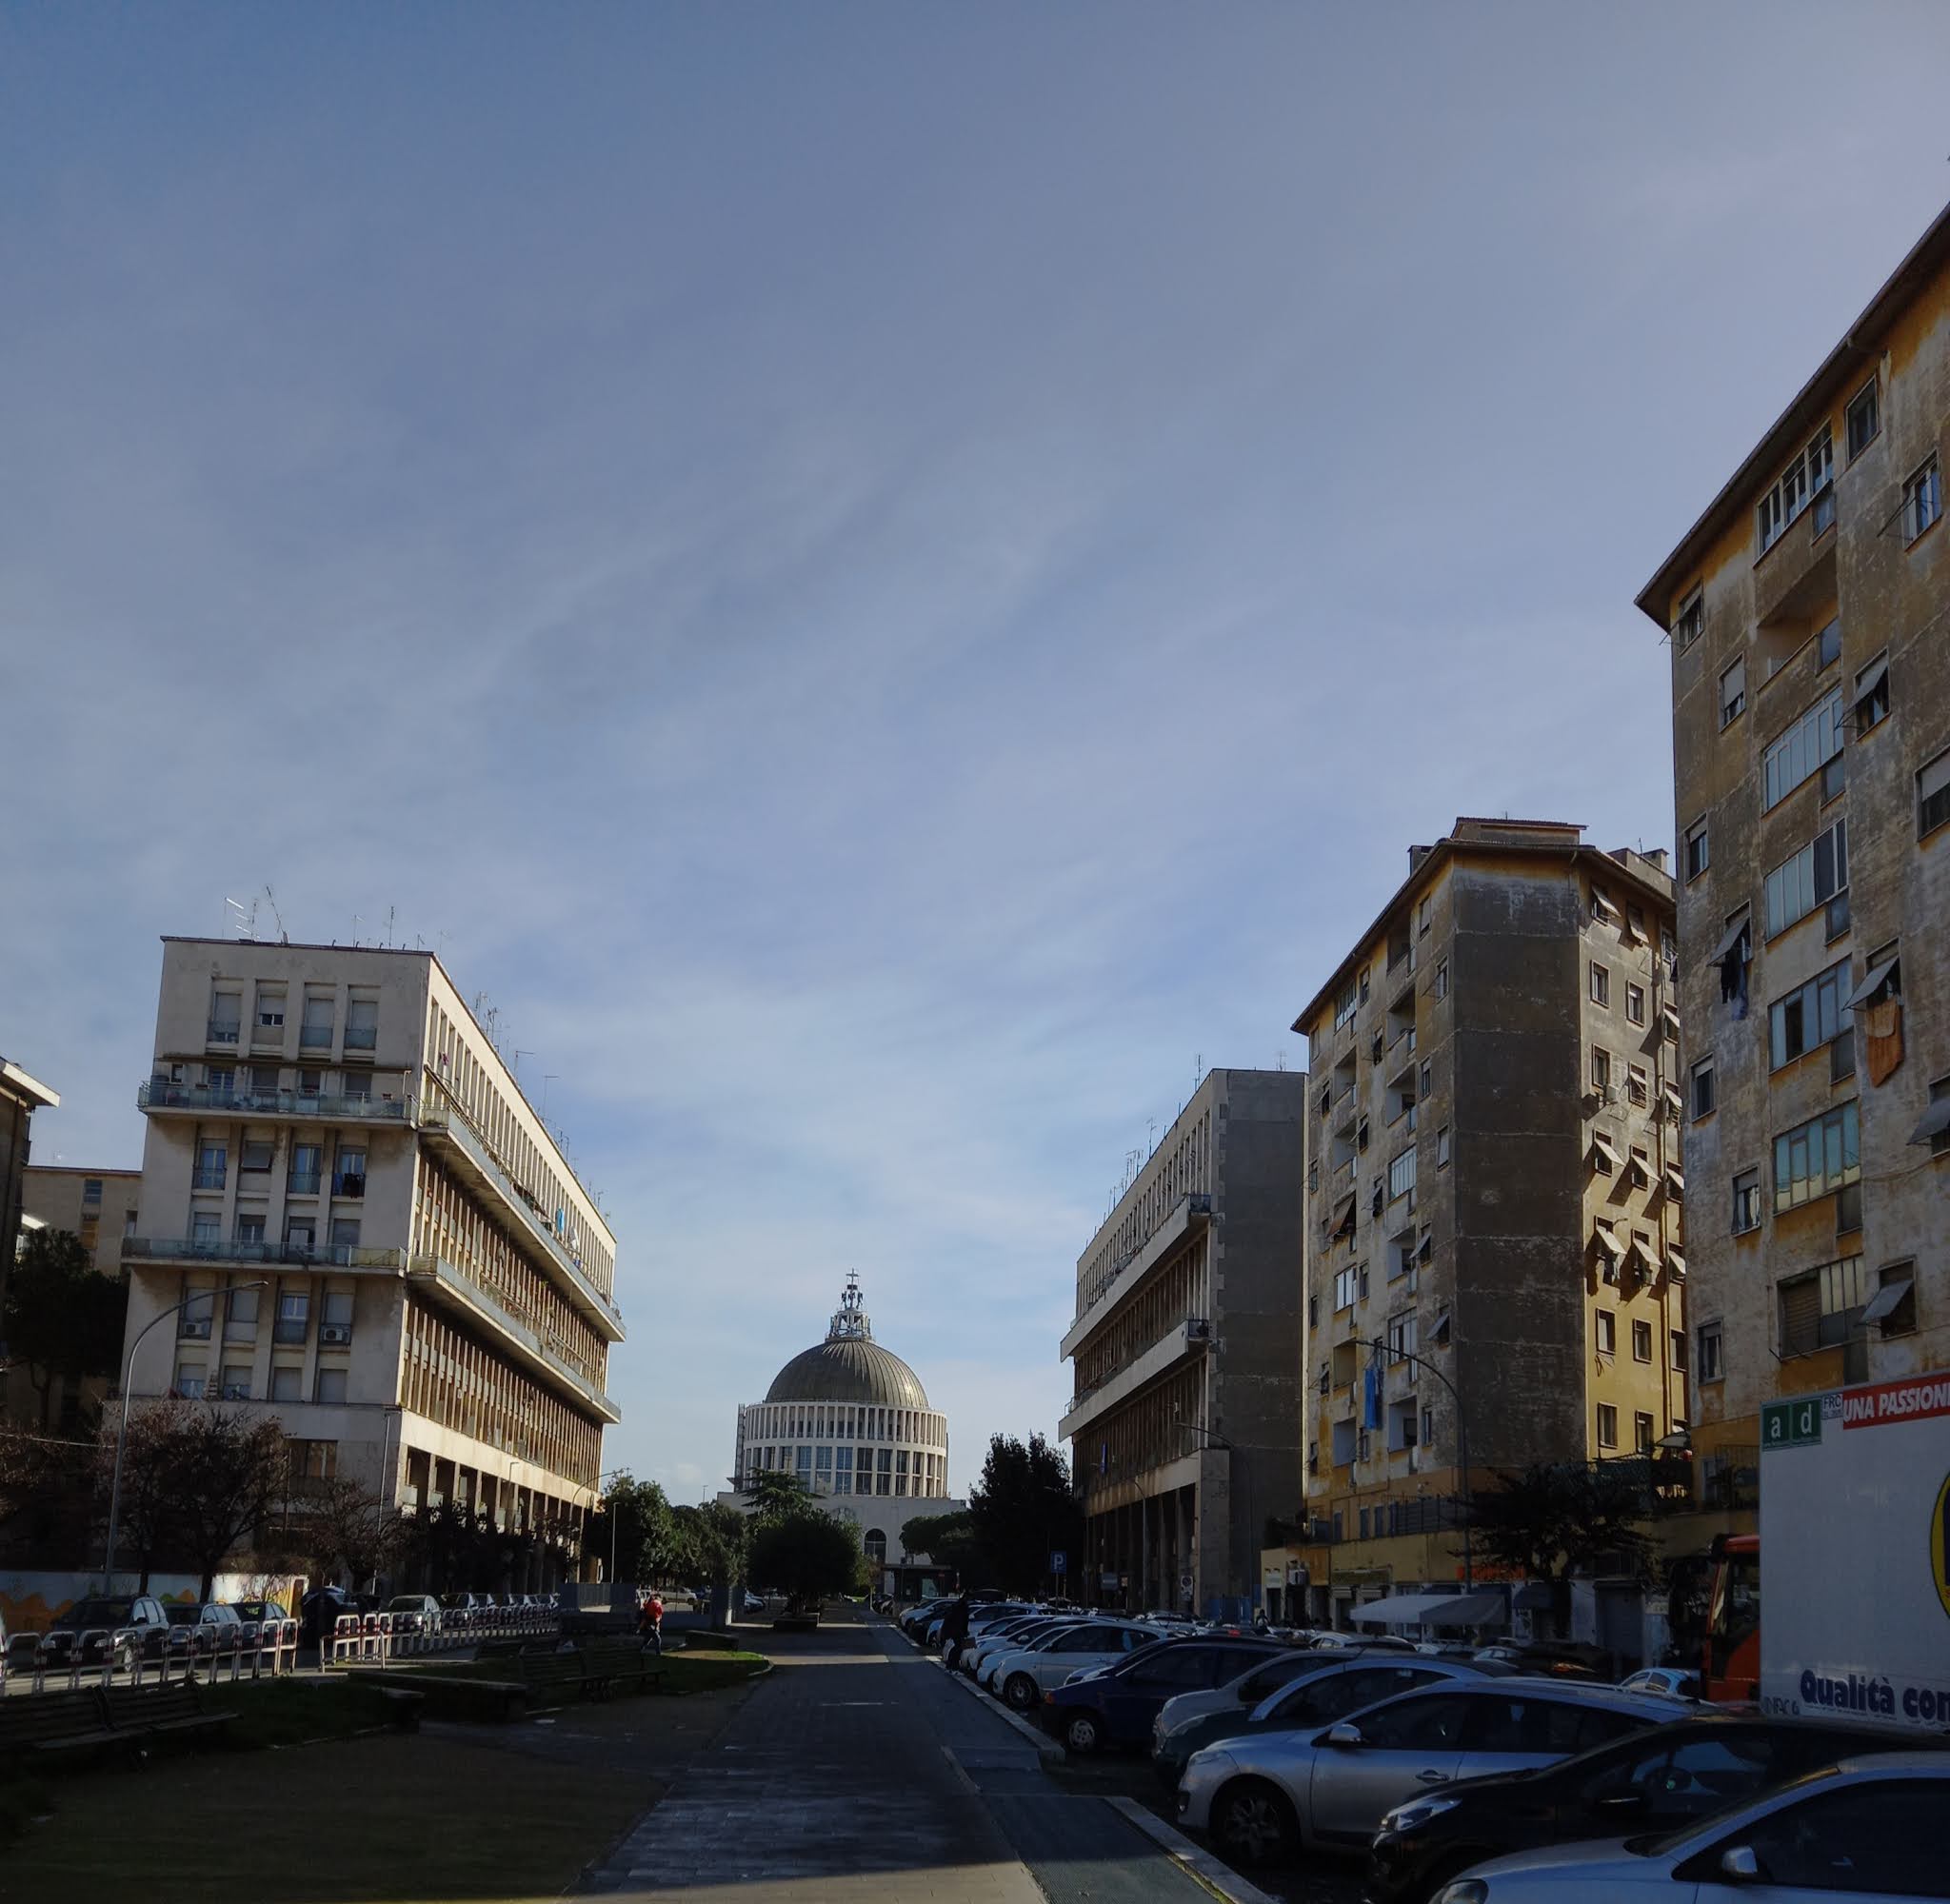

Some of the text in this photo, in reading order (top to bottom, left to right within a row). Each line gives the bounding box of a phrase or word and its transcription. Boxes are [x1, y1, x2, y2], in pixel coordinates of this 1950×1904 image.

[1771, 1403, 1812, 1438] a d
[1843, 1382, 1950, 1422] UNA PASSION
[1054, 1554, 1064, 1570] P
[1801, 1670, 1895, 1715] Qualità
